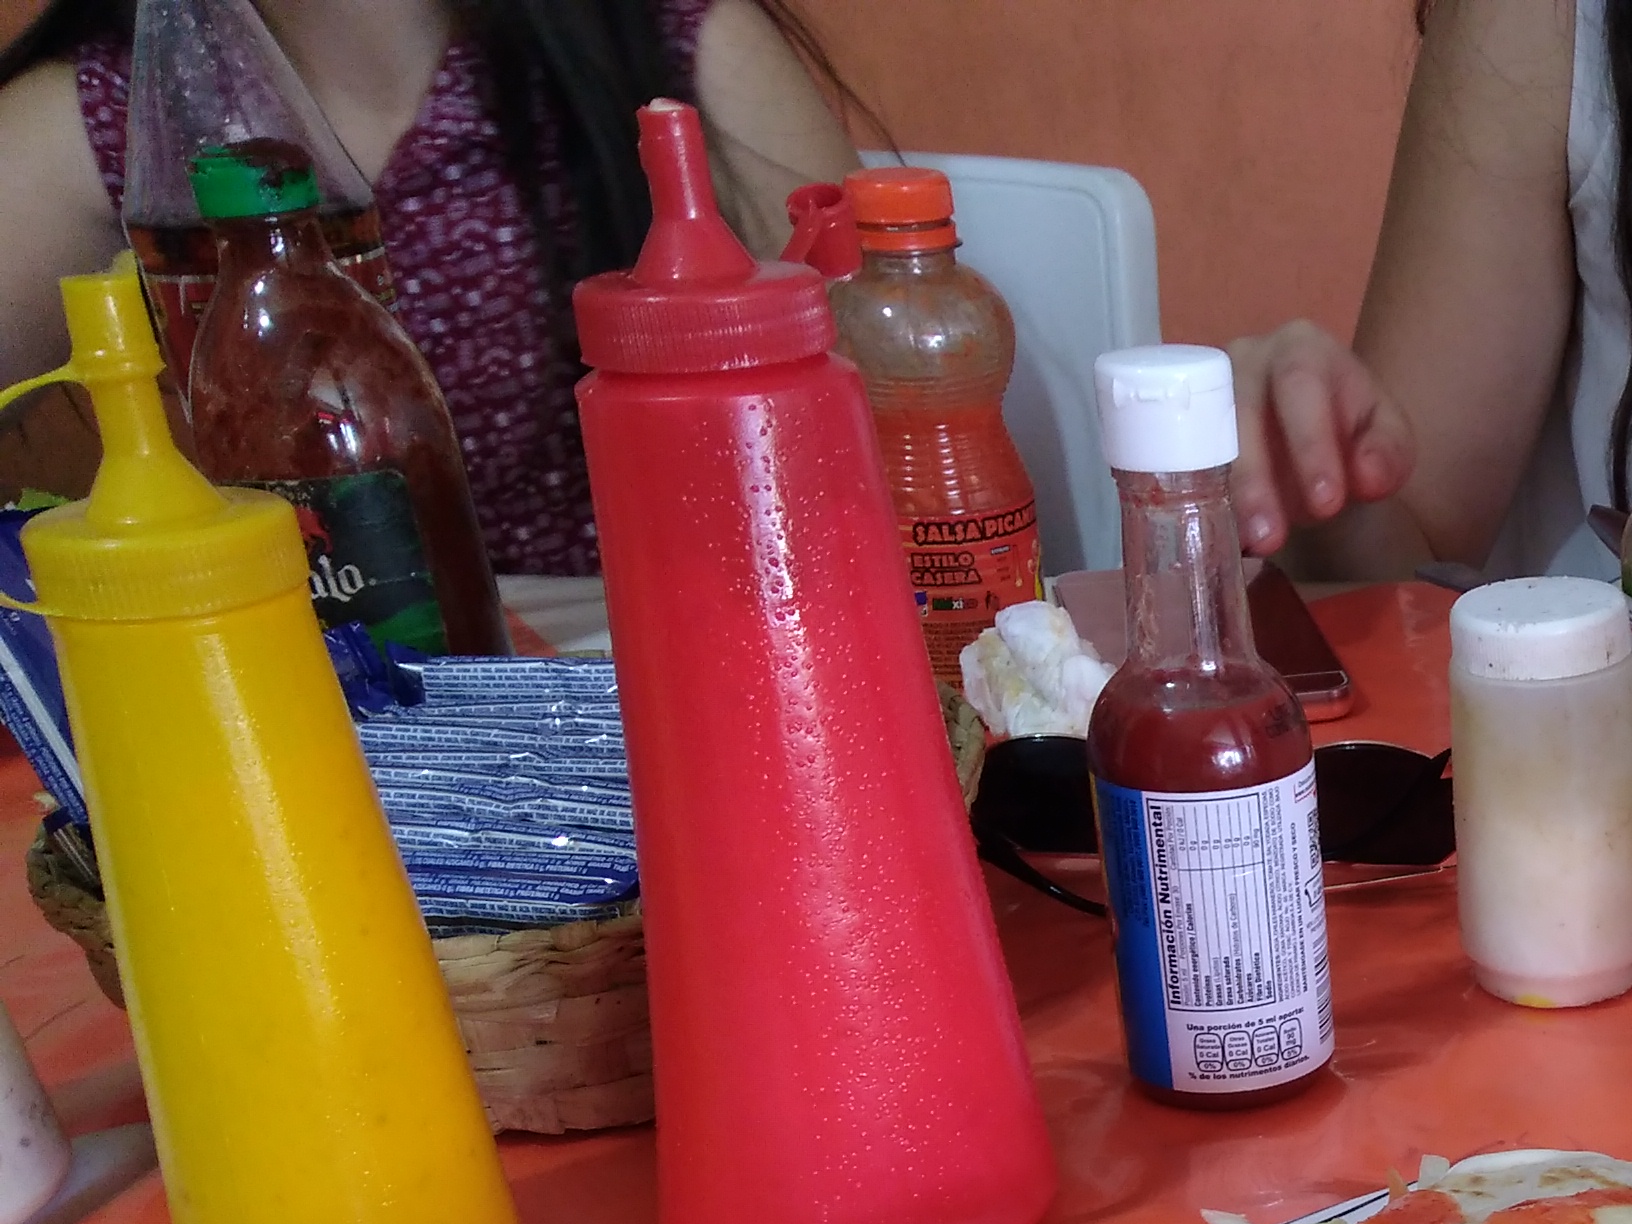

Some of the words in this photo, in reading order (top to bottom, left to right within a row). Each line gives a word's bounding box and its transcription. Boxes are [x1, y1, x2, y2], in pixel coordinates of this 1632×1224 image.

[913, 520, 983, 545] SALSA
[983, 505, 1036, 538] PICAN
[911, 551, 974, 568] ESTILO
[308, 554, 365, 602] alo
[910, 569, 982, 586] CASERA
[1149, 805, 1171, 904] Nutrimental
[1161, 909, 1182, 1005] Información
[1186, 1023, 1204, 1031] Una
[1207, 1023, 1242, 1033] porción
[1266, 1016, 1277, 1024] ml
[1263, 1043, 1276, 1051] Cal
[1229, 1063, 1282, 1079] nutrimentos
